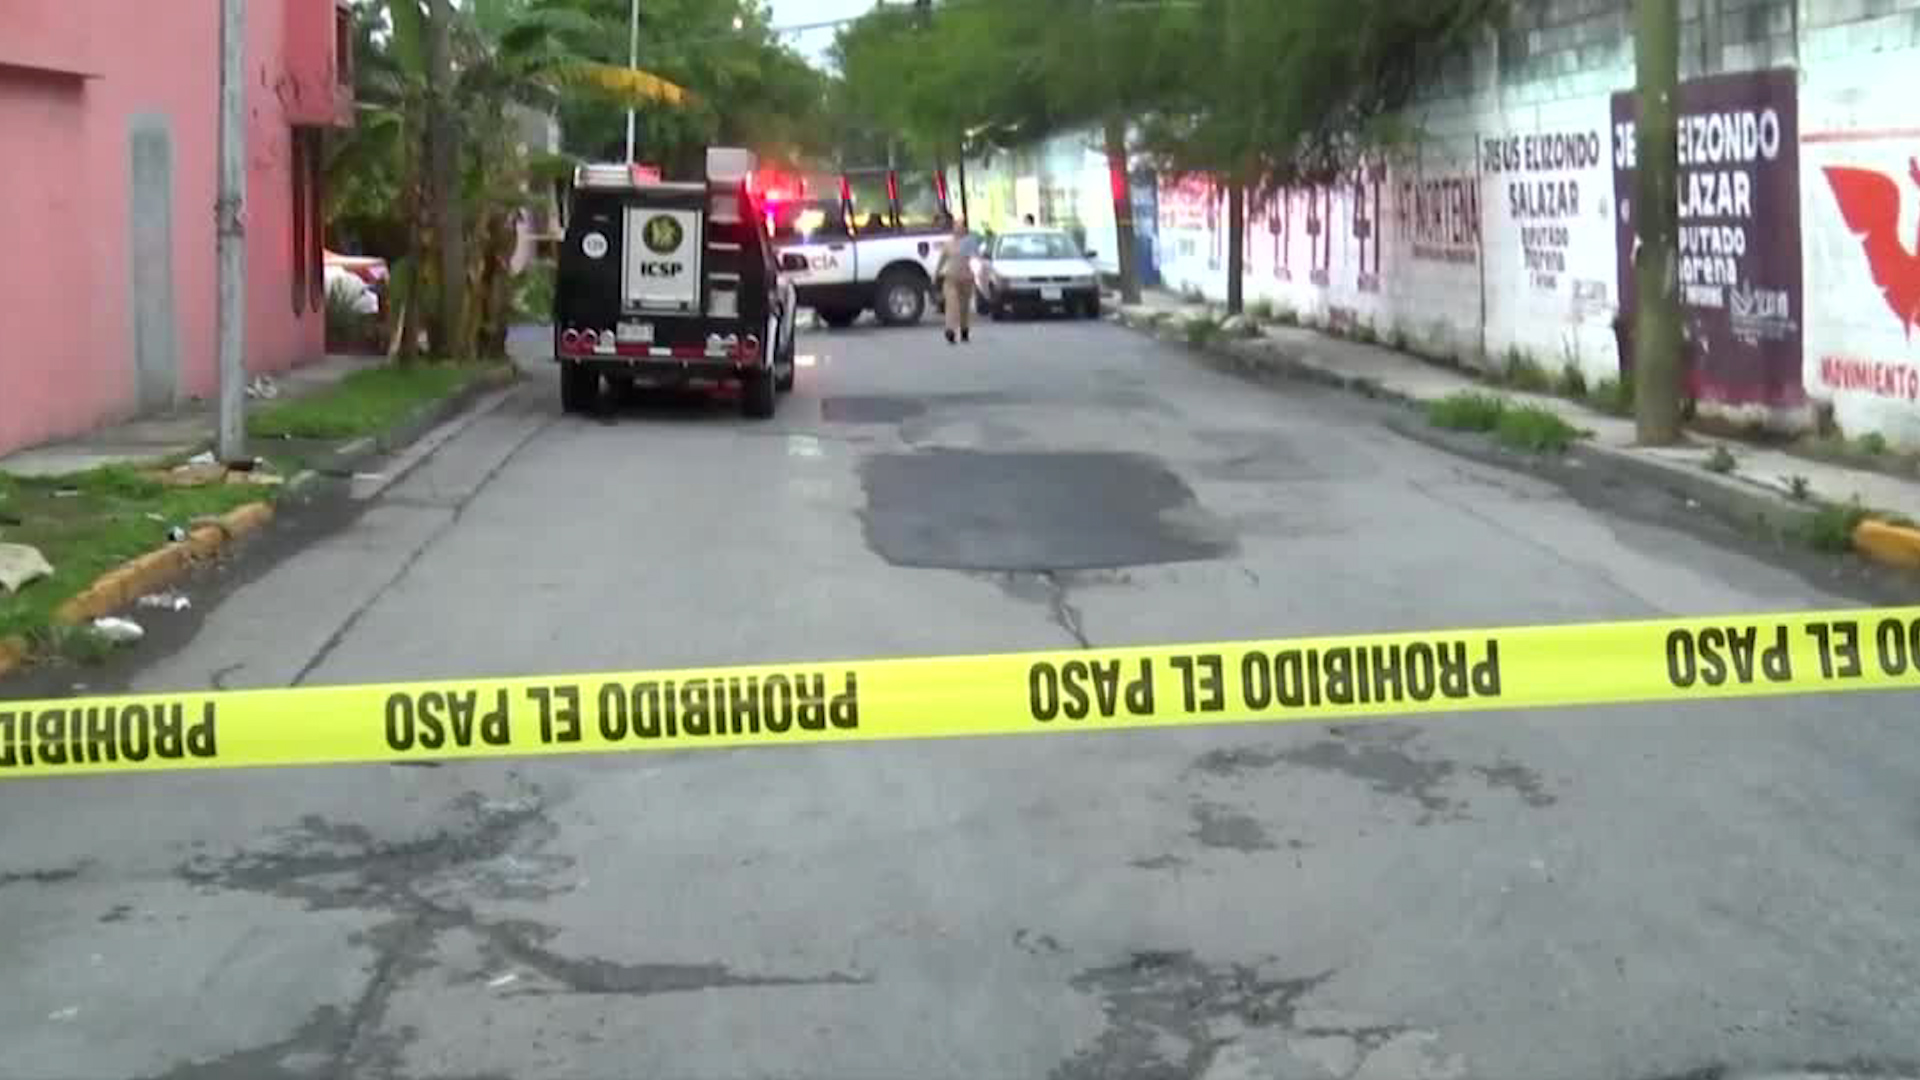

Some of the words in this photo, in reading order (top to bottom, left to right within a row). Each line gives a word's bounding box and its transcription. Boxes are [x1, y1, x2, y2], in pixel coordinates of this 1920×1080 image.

[1509, 179, 1579, 219] SALAZAR
[1677, 170, 1751, 218] LAZAR
[641, 261, 683, 278] ICSP
[1678, 225, 1746, 256] PUTADO
[1241, 639, 1502, 711] PROHIBIDO
[1665, 624, 1792, 688] PASO
[1805, 621, 1862, 679] EL
[599, 671, 860, 741] PROHIBIDO
[1029, 658, 1155, 722] PASO
[1170, 655, 1225, 713] EL
[385, 687, 511, 752] PASO
[526, 685, 582, 744] EL
